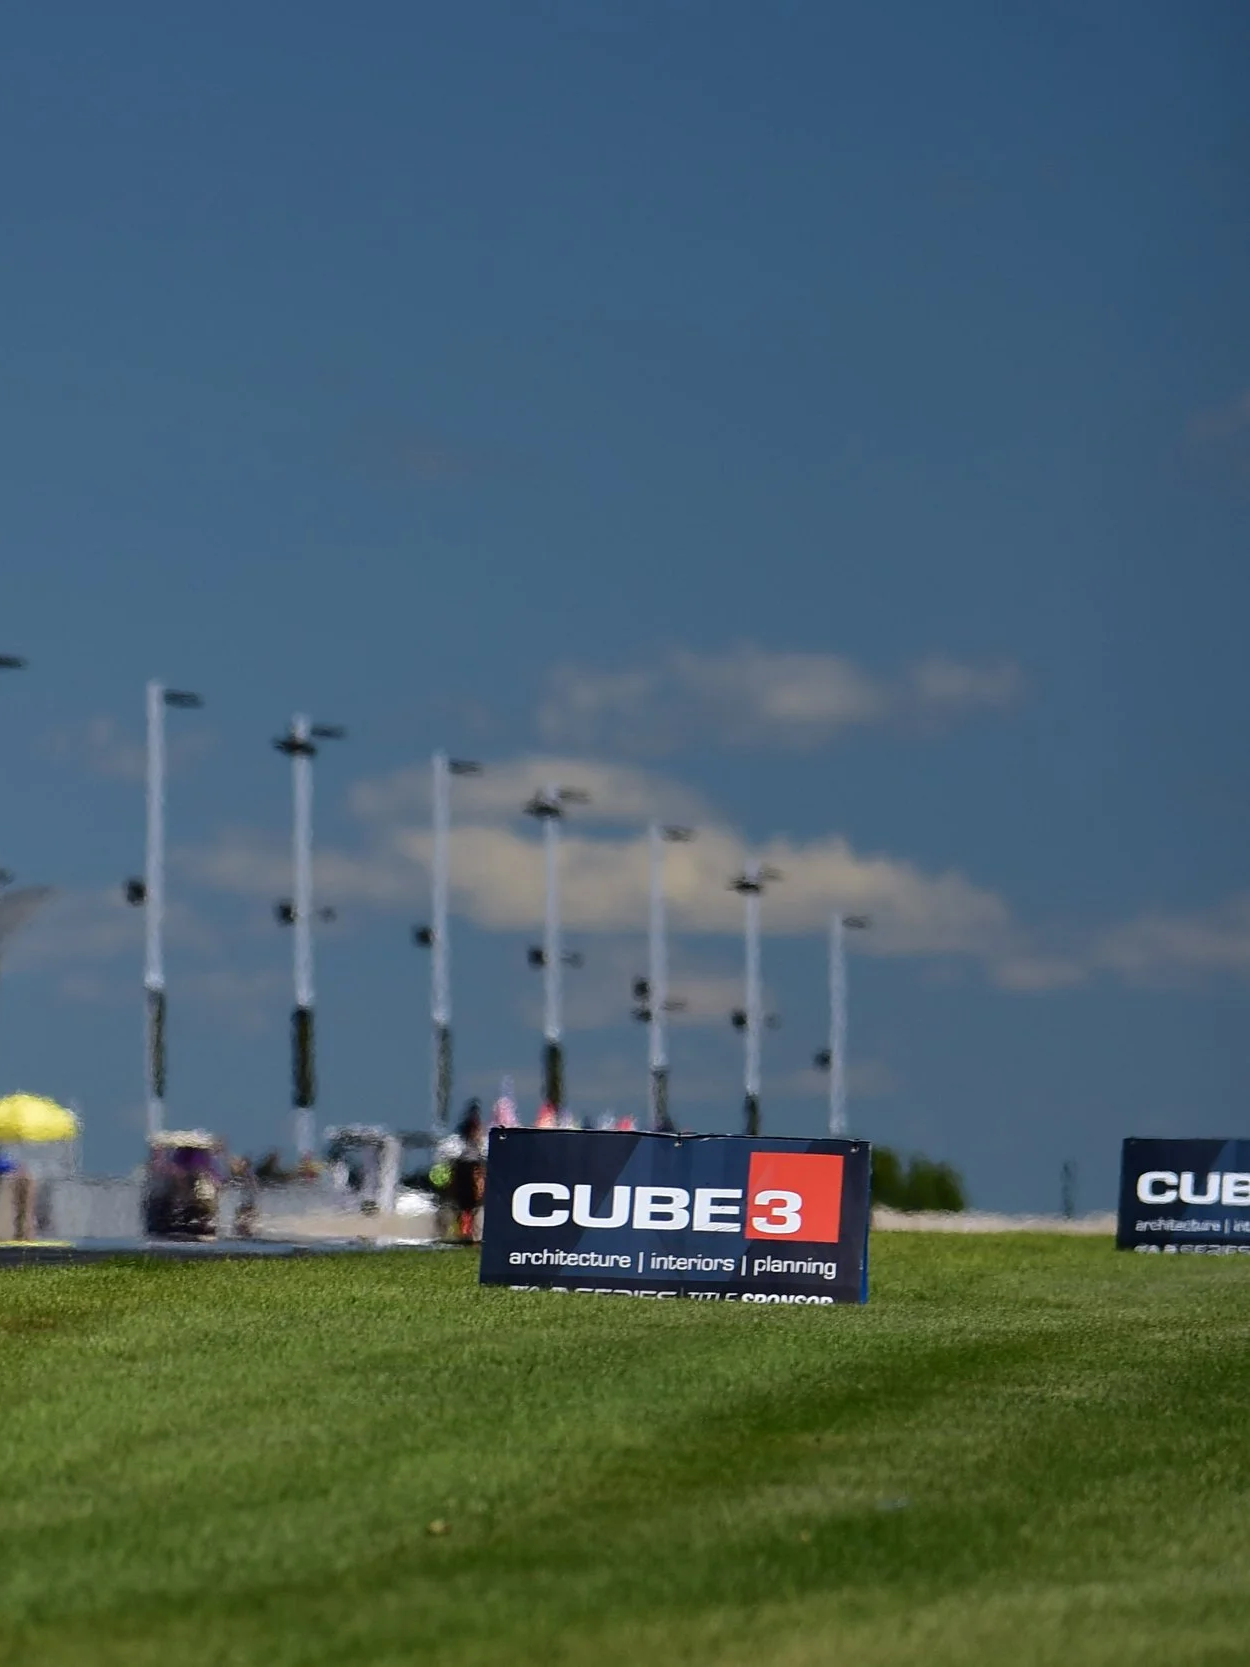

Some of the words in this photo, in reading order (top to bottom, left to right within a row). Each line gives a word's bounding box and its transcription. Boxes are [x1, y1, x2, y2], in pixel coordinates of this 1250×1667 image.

[1134, 1217, 1221, 1232] architecture
[509, 1248, 632, 1269] architecture
[650, 1252, 735, 1272] interiors
[752, 1254, 838, 1280] planning
